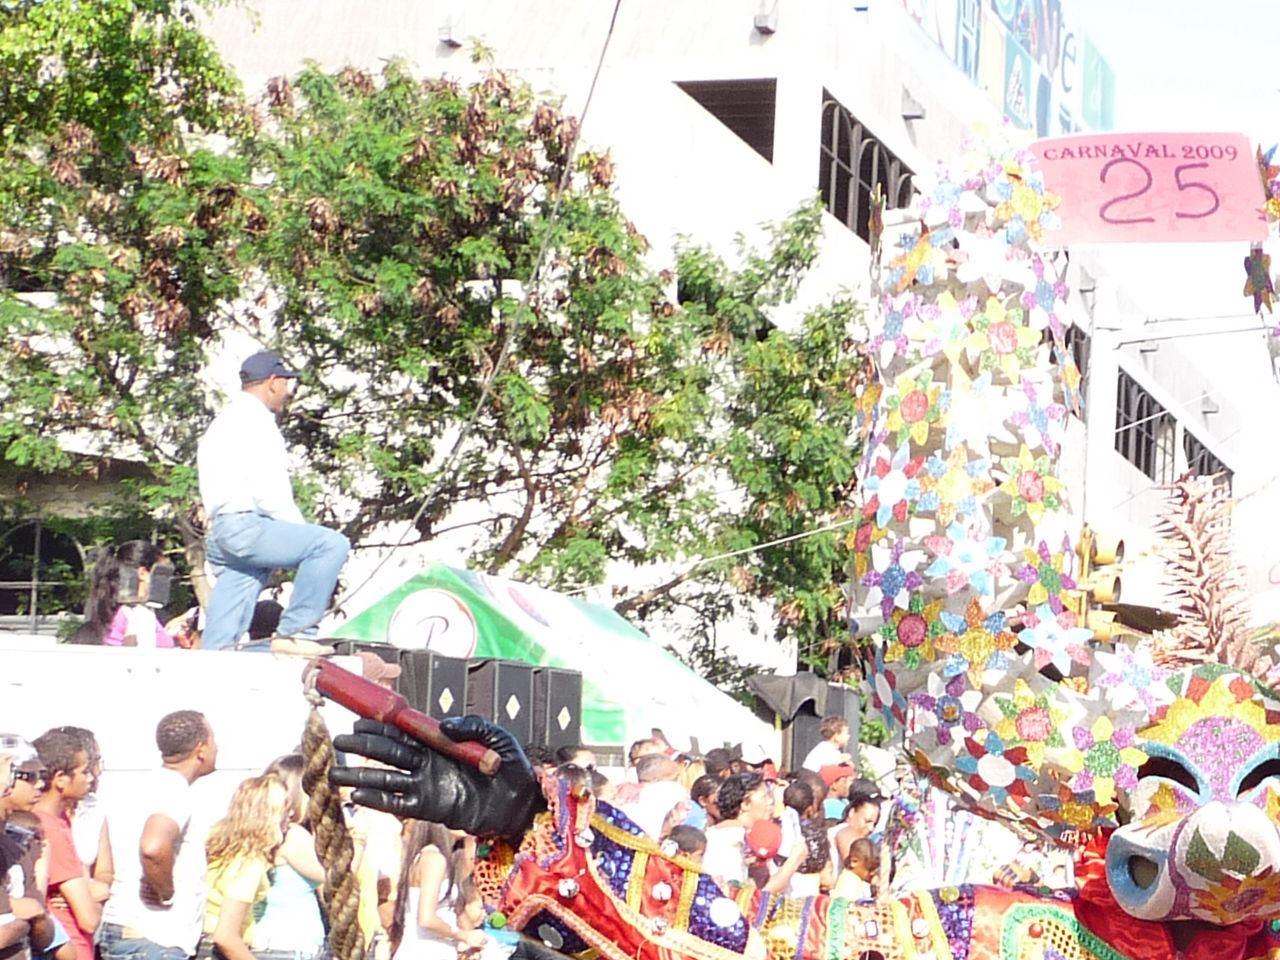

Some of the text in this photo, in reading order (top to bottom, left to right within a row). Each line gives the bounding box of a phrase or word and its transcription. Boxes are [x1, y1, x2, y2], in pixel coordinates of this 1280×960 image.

[1043, 143, 1238, 160] CARNAVAL 2009
[1099, 157, 1220, 224] 25
